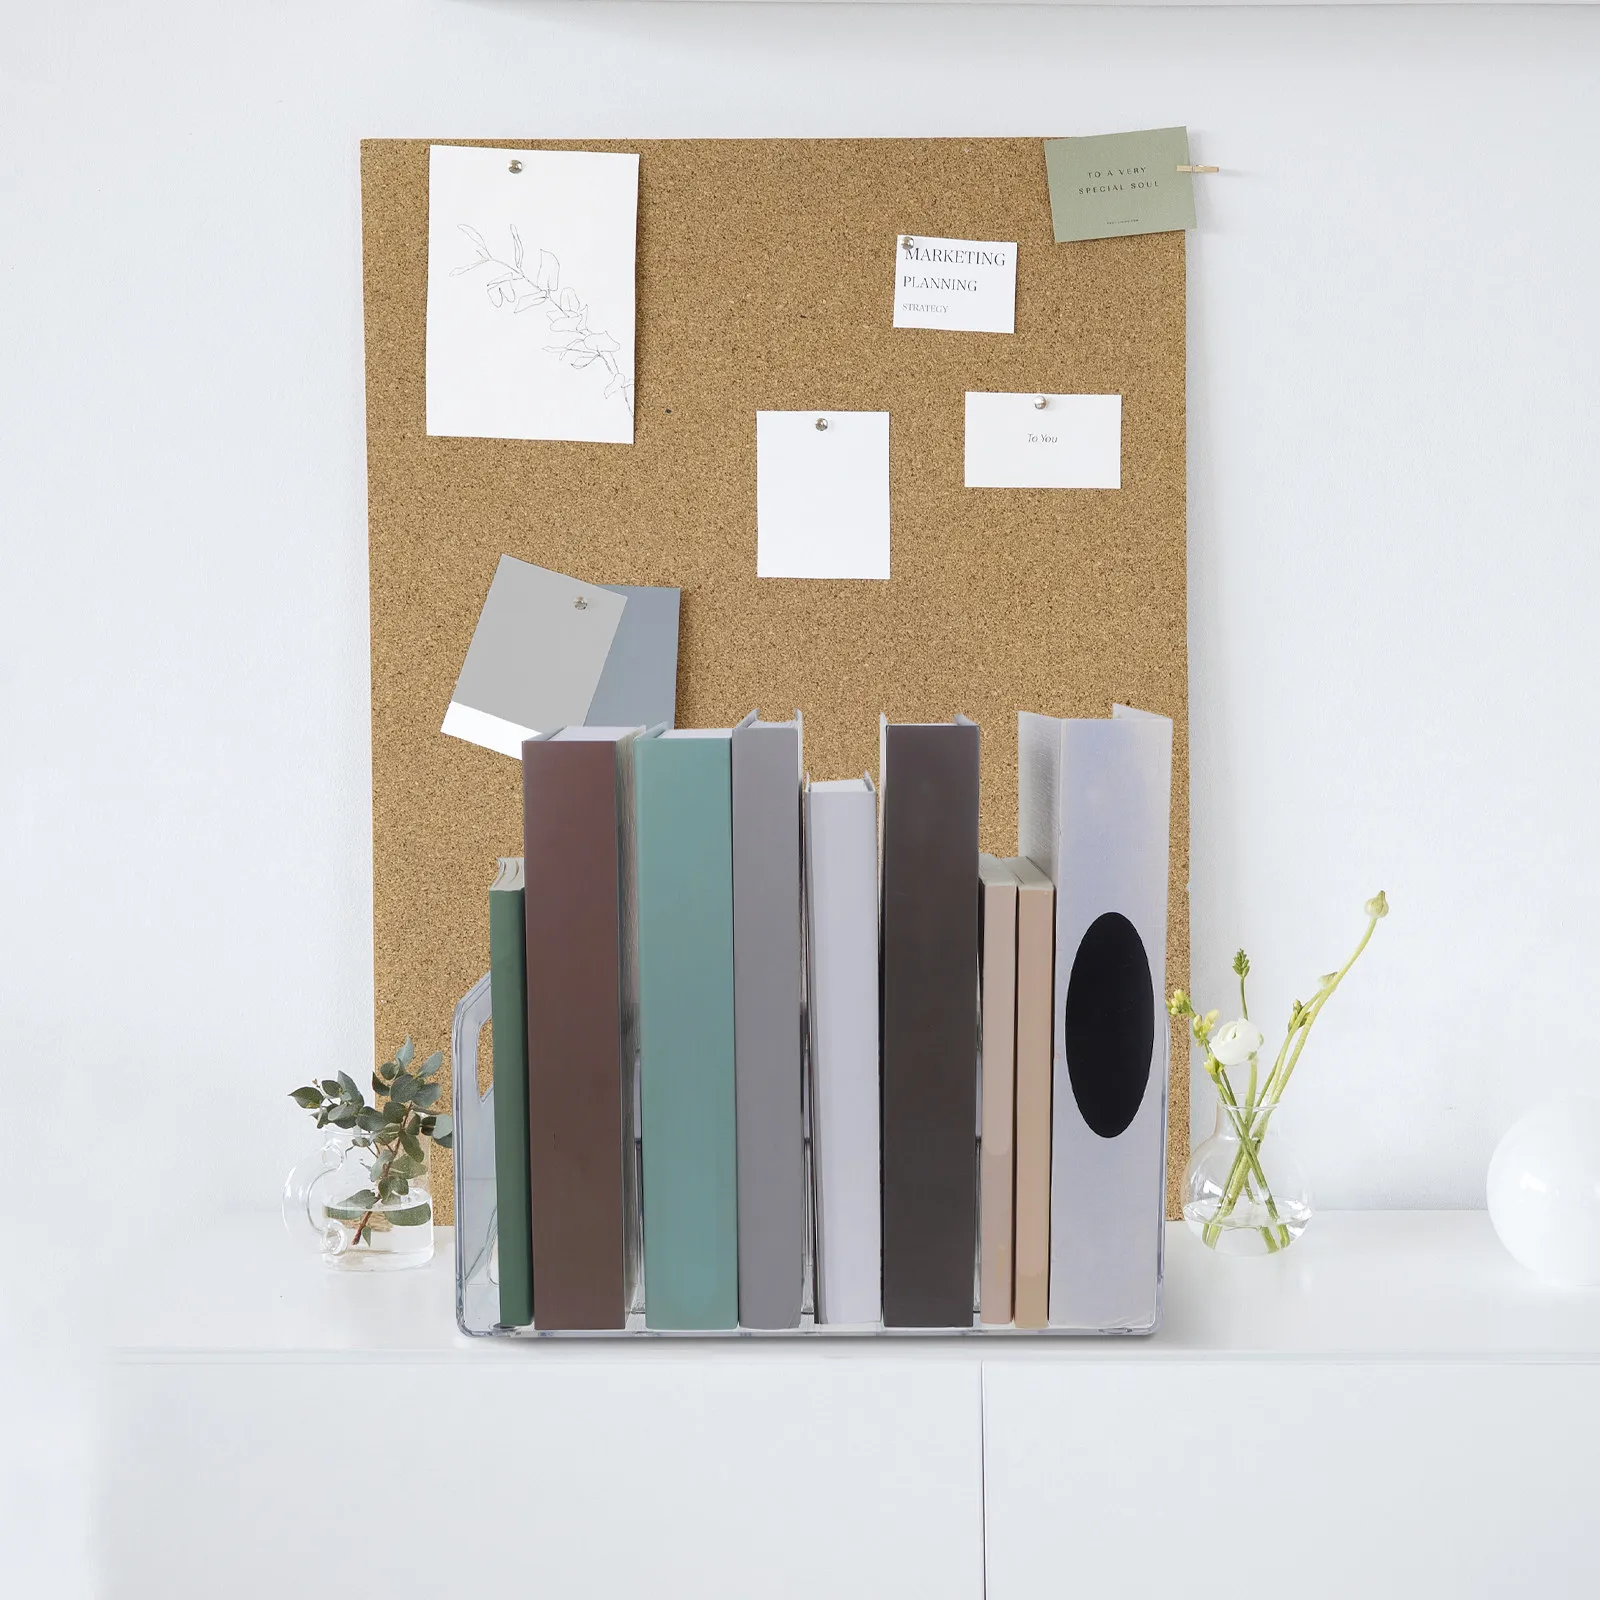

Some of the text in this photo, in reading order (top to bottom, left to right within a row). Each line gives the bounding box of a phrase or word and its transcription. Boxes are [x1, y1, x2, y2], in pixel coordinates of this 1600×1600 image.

[1088, 171, 1101, 179] TO
[1118, 167, 1146, 176] VERY
[1078, 181, 1159, 194] SPECIAL SOUL
[905, 247, 1006, 267] MARKETING
[903, 275, 978, 292] PLANNING
[902, 303, 949, 313] STRATEGY
[1027, 433, 1058, 443] To You
